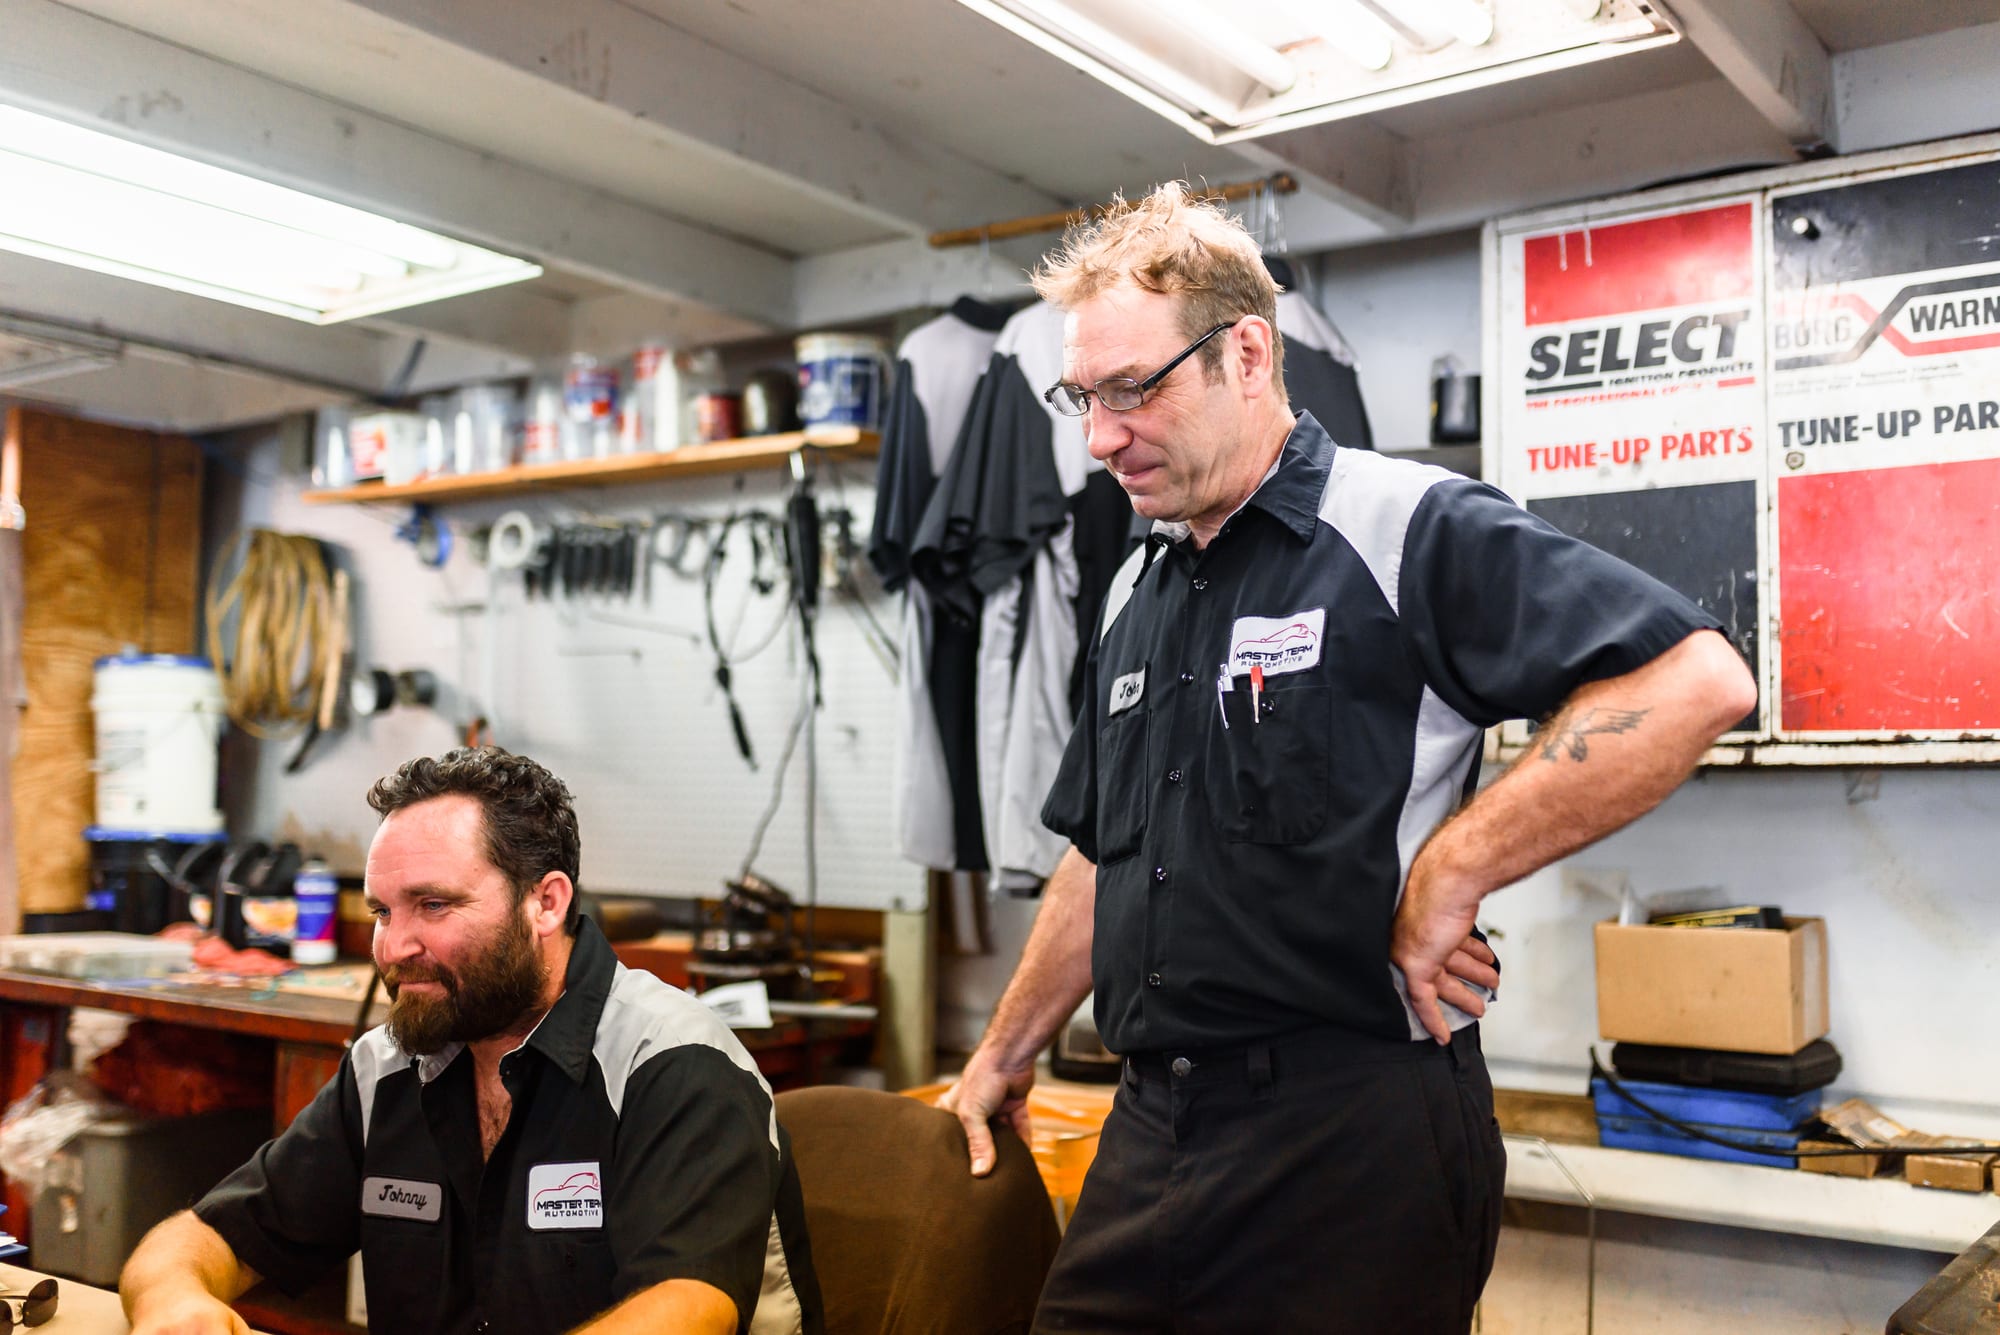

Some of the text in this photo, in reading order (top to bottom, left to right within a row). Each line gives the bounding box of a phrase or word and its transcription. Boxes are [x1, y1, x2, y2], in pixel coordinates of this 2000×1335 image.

[1525, 309, 1751, 380] SELECT
[1777, 401, 2000, 448] TUNE-UP PAR
[1528, 427, 1754, 472] TUNE-UP PARTS
[1236, 644, 1313, 661] MASTER TEAM
[1241, 656, 1303, 668] AUTOMOTIVE
[379, 1184, 427, 1211] Johnny
[537, 1199, 601, 1210] MASTER TEA
